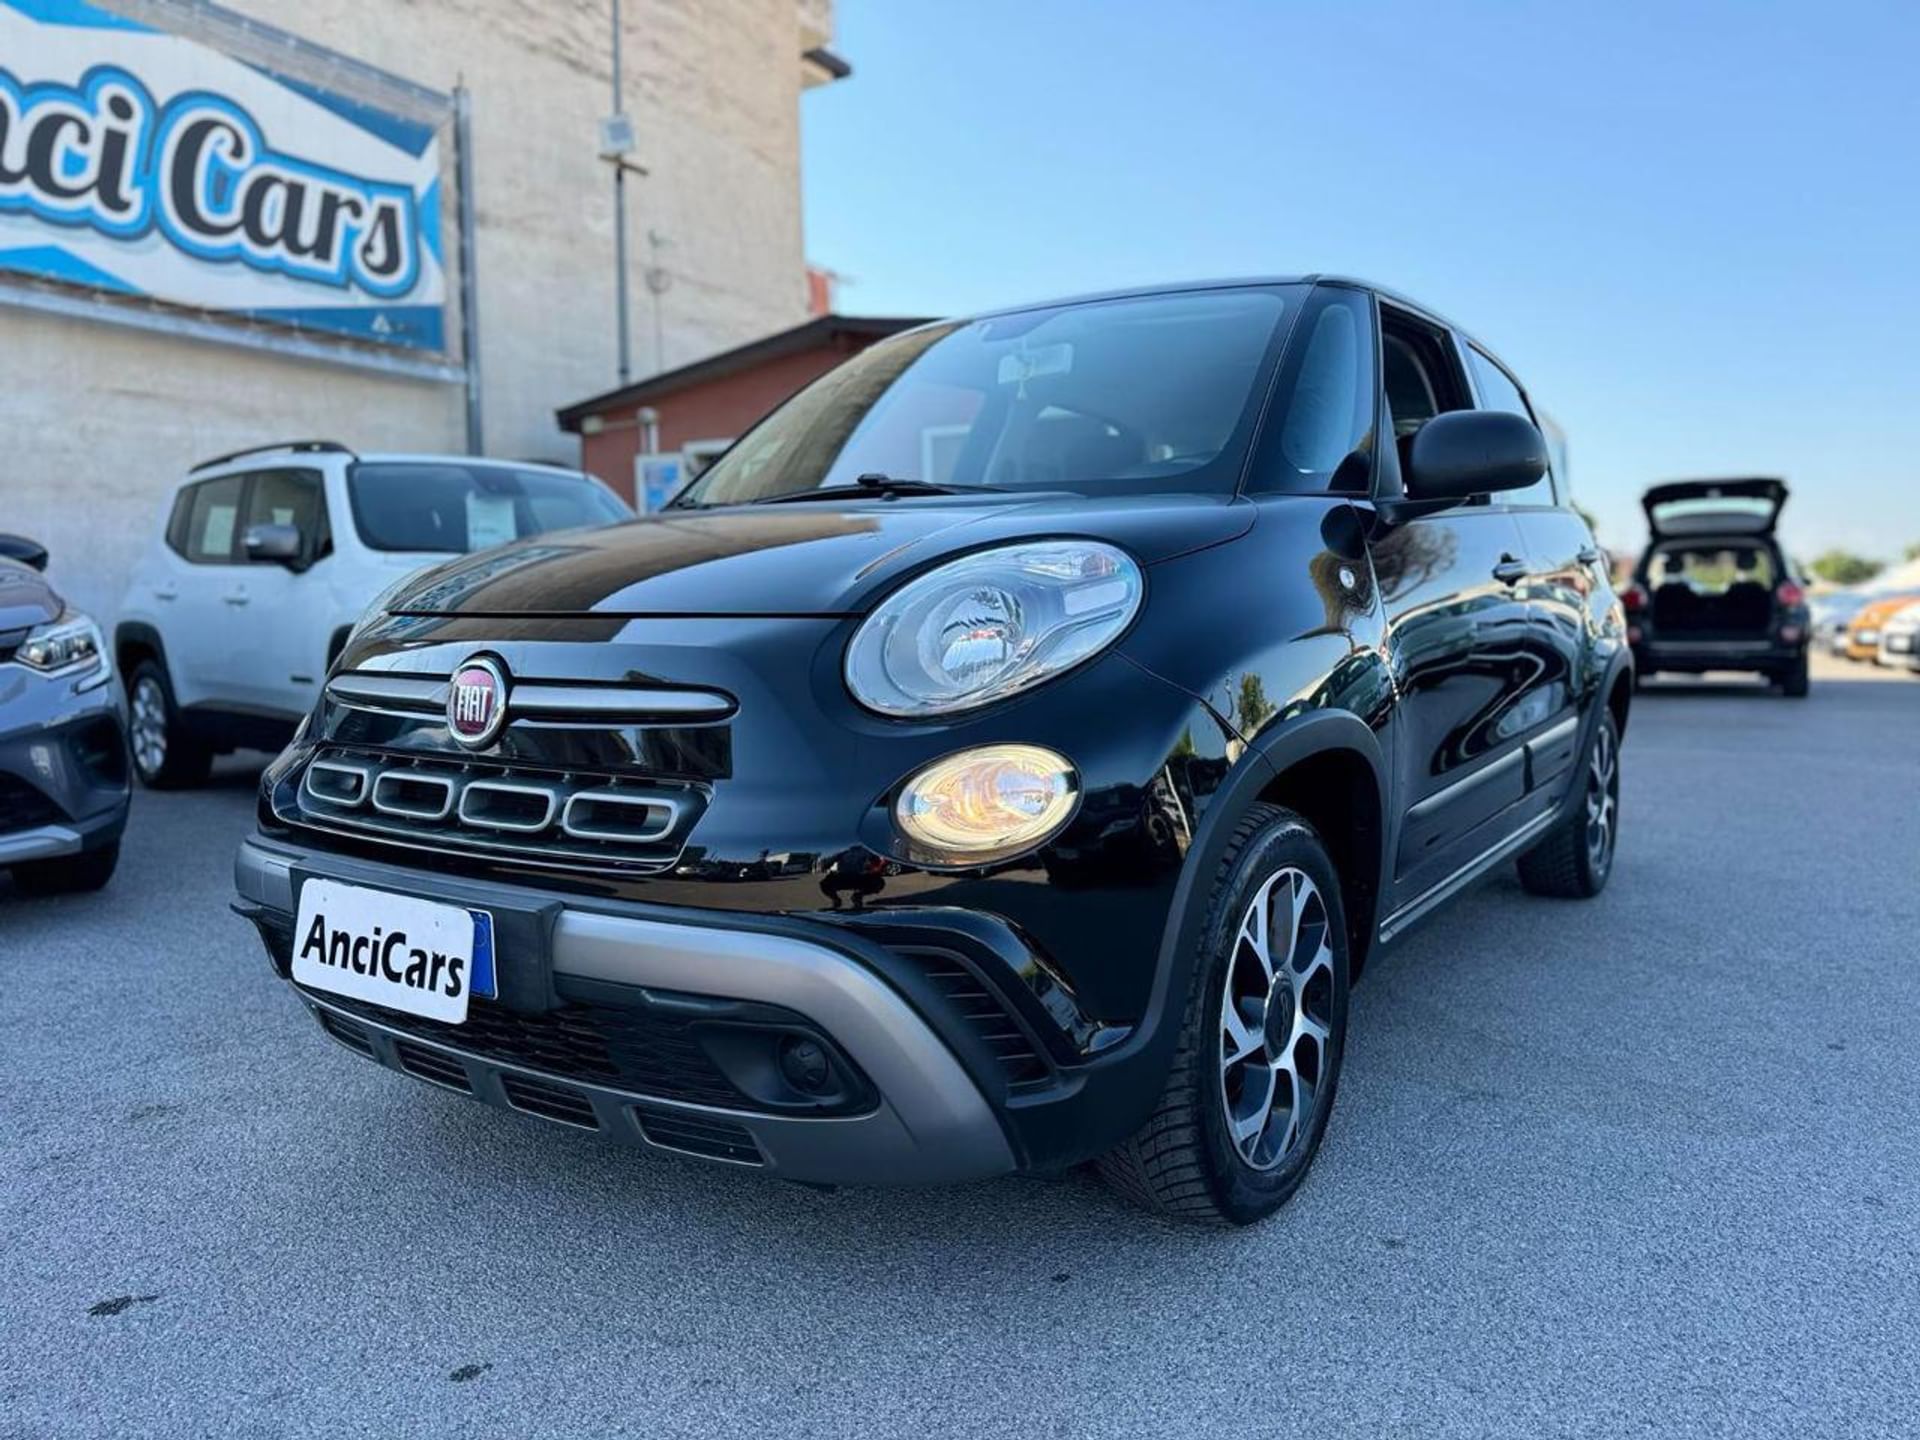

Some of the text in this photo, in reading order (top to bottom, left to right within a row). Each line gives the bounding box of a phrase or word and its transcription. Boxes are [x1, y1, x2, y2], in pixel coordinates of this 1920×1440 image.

[171, 118, 401, 276] Cars
[456, 685, 492, 722] FIAT
[300, 913, 465, 998] AnciCars
